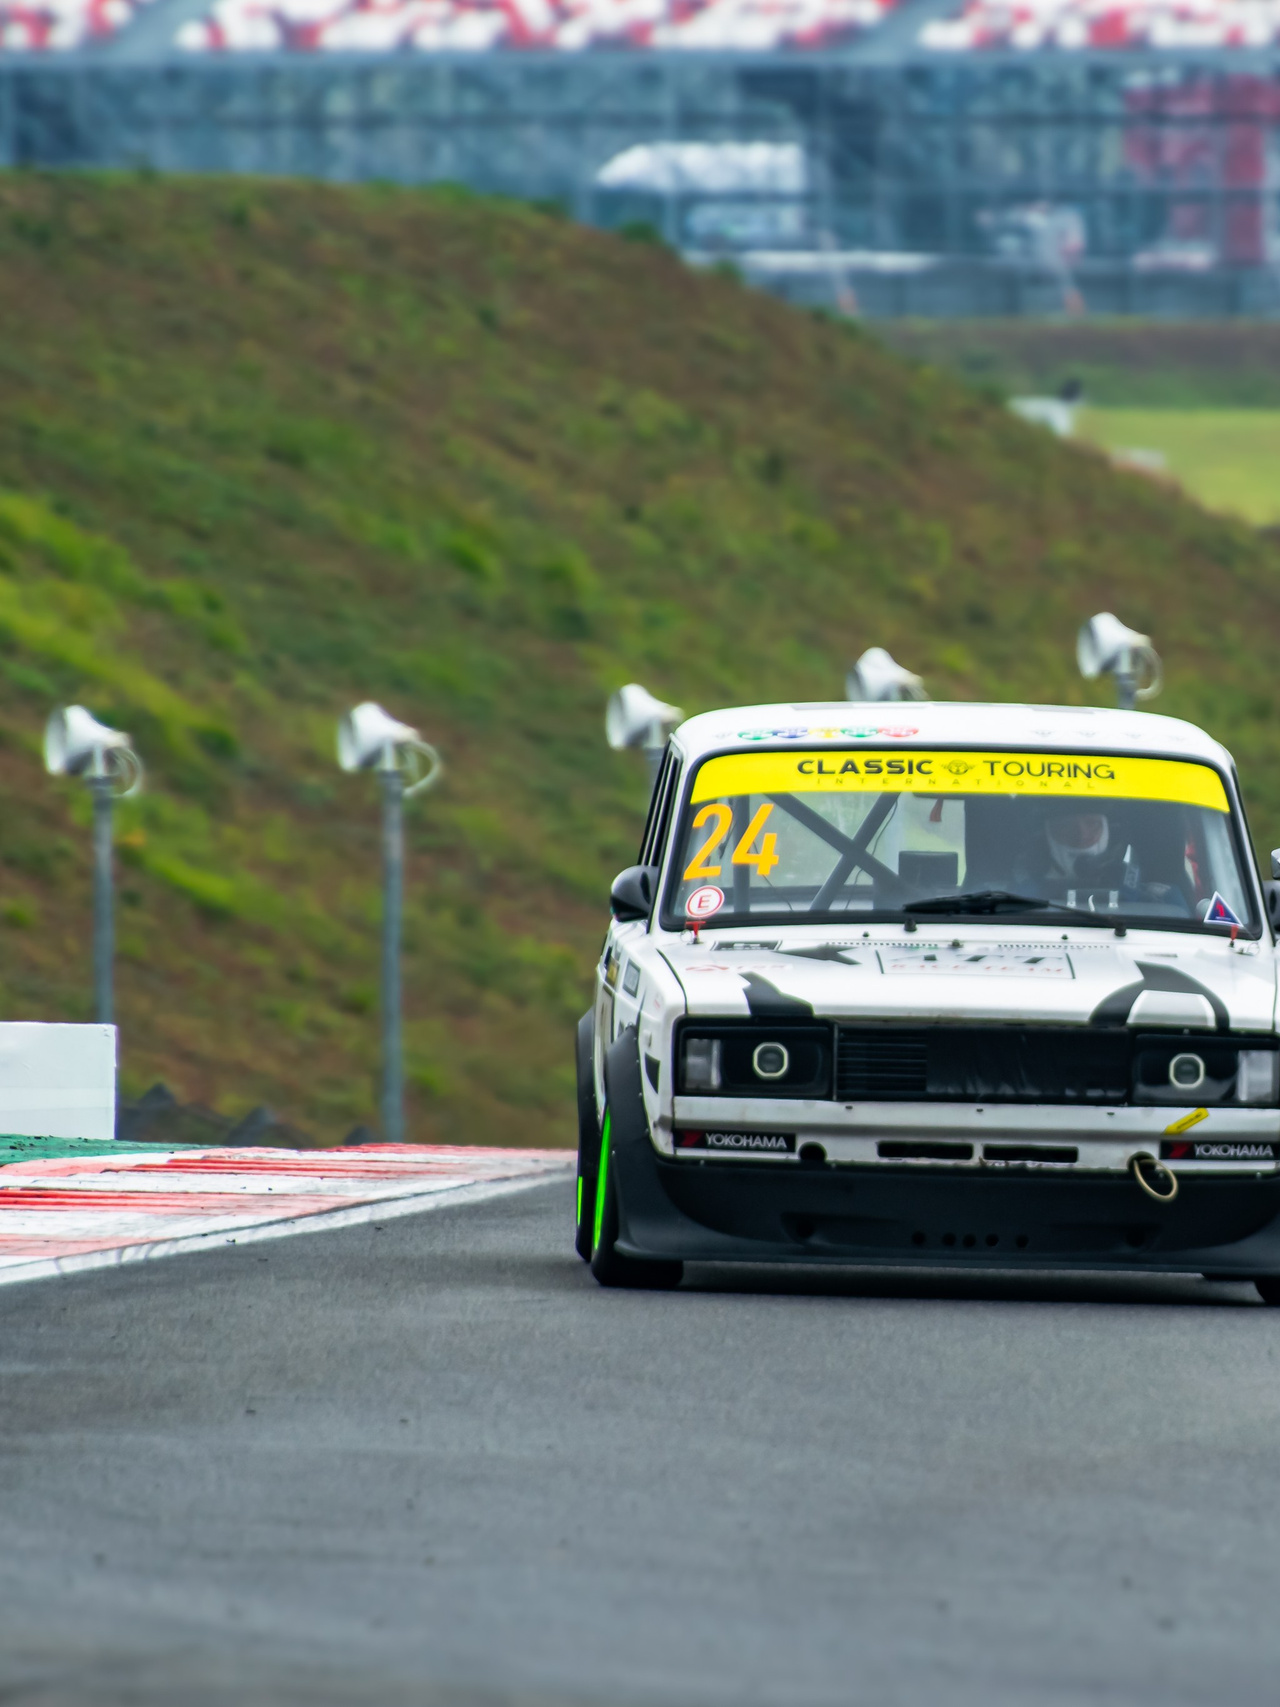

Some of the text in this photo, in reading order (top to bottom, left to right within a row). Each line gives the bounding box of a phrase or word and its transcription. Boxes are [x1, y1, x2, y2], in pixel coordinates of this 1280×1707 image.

[797, 759, 1115, 779] CLASSIC TOURING
[816, 776, 1095, 789] INTERNATIONAL
[683, 803, 779, 881] 24
[697, 894, 712, 909] E
[705, 1132, 787, 1148] YOKOHAMA
[1194, 1143, 1273, 1157] YOKOHAMA
